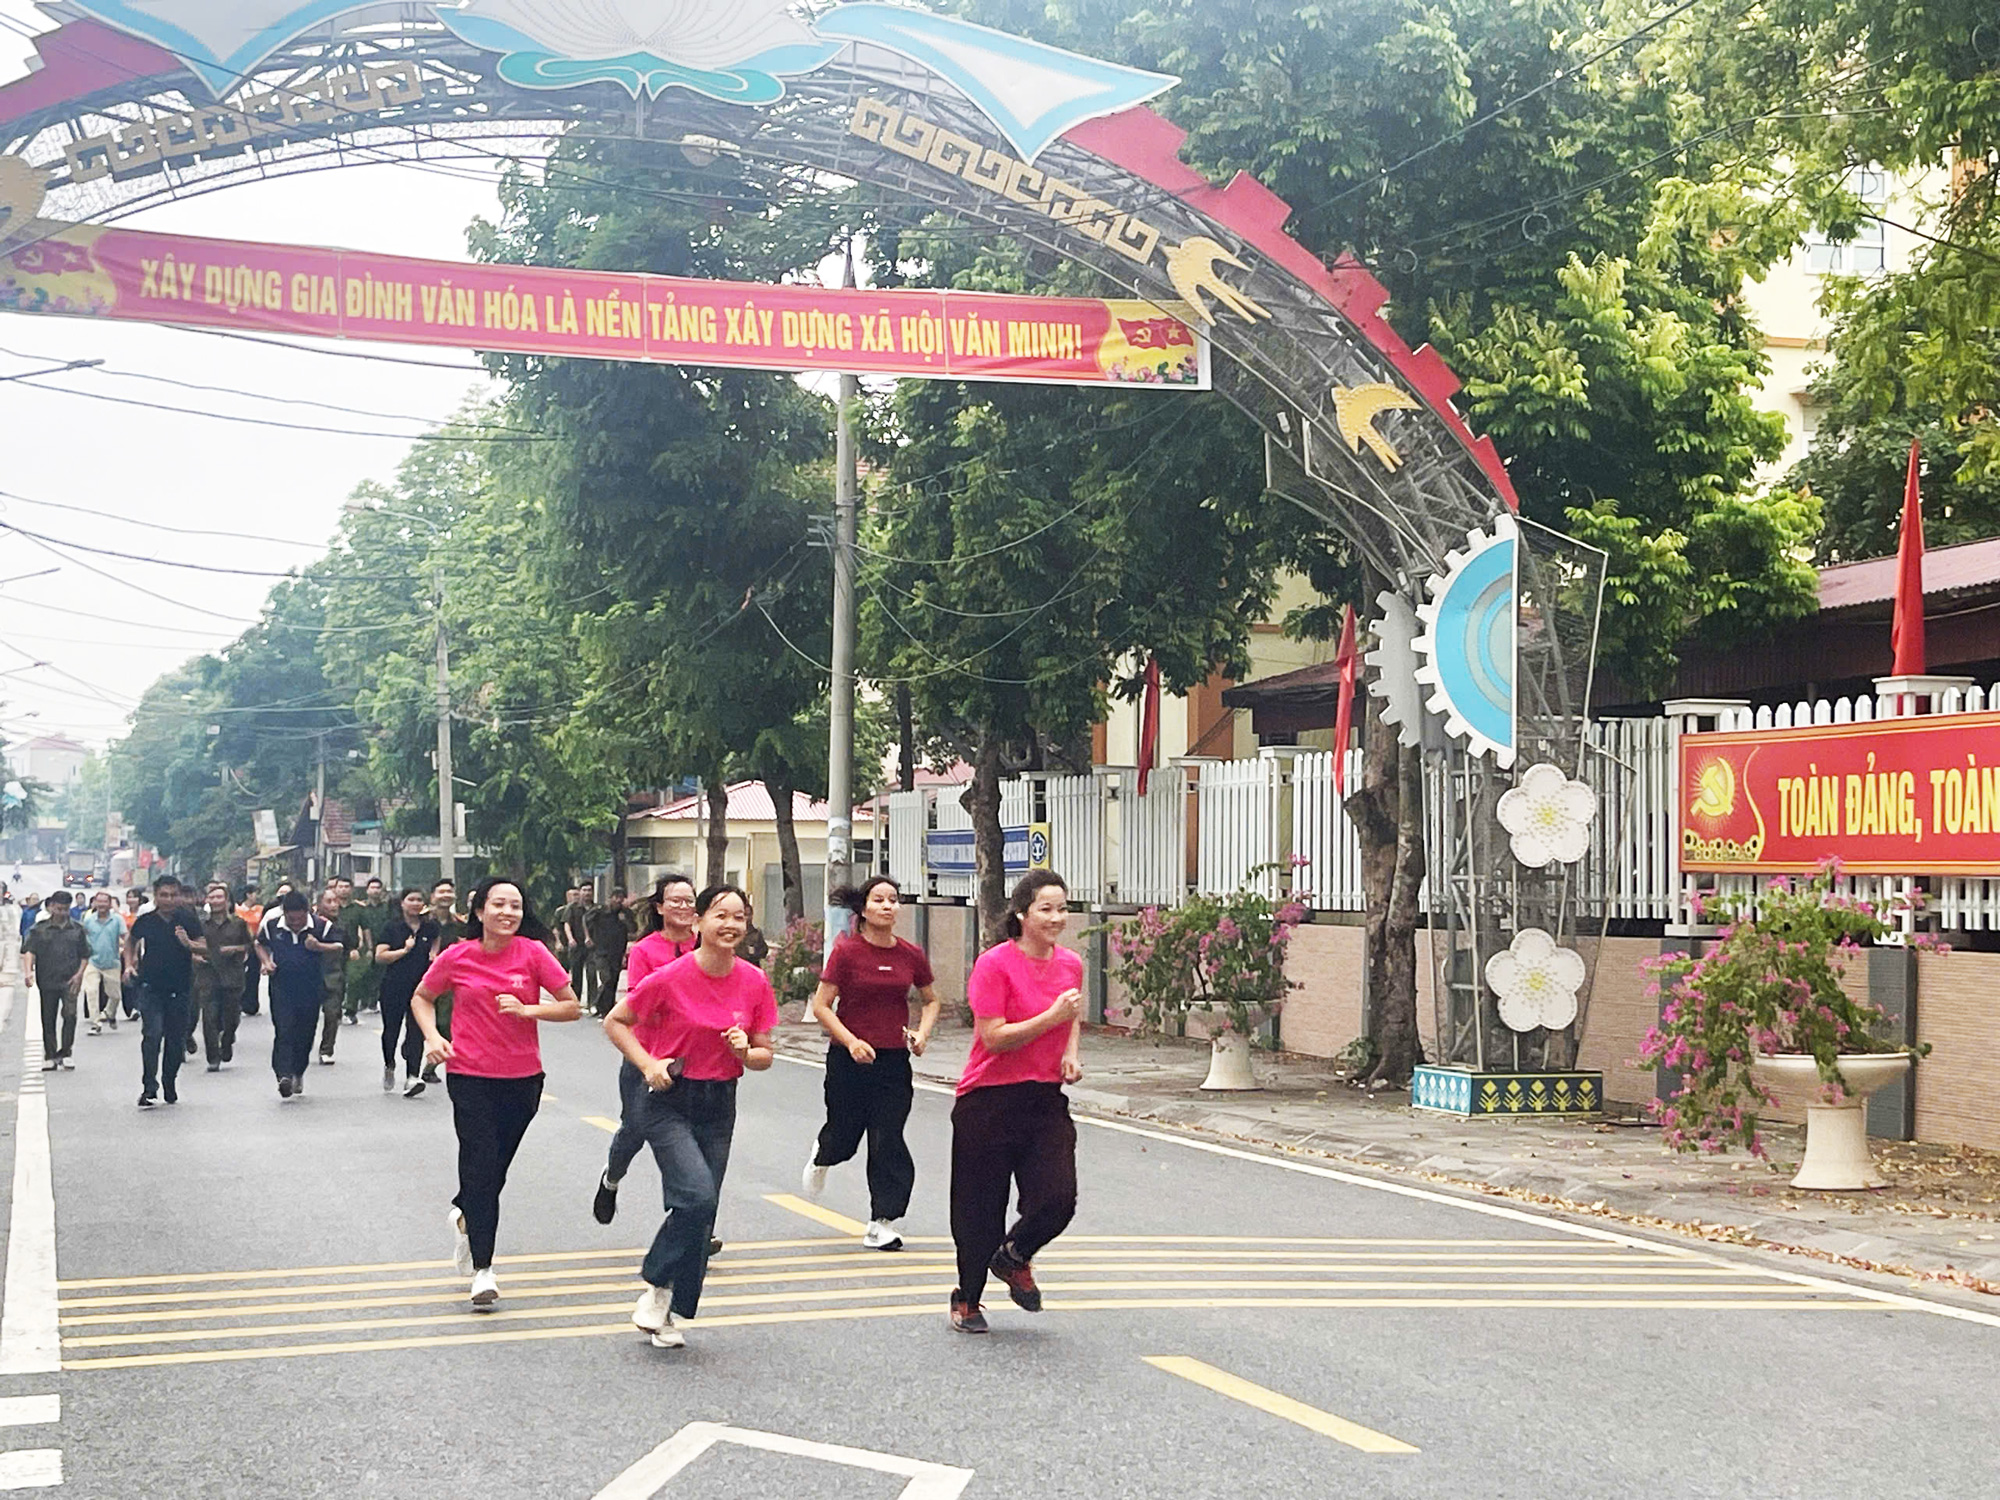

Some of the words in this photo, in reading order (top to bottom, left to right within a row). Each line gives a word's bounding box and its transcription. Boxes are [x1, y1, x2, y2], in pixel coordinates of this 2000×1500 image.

[139, 252, 196, 300] XÂY
[205, 264, 282, 314] DỰNG
[291, 273, 337, 316] GIA
[346, 271, 412, 322] ĐÌNH
[420, 279, 475, 327] VĂN
[484, 284, 538, 332] HÓA
[545, 289, 579, 335] LÀ
[648, 292, 717, 343] TẢNG
[724, 300, 773, 346] XÂY
[782, 308, 853, 357] DỰNG
[859, 308, 895, 352] XÃ
[901, 309, 943, 362] HỘI
[949, 311, 1001, 357] VĂN
[1008, 321, 1082, 360] MINH!
[1778, 763, 1838, 837] TOÀN
[1845, 751, 1922, 843] ĐẢNG,
[1930, 753, 2000, 835] TOÀN
